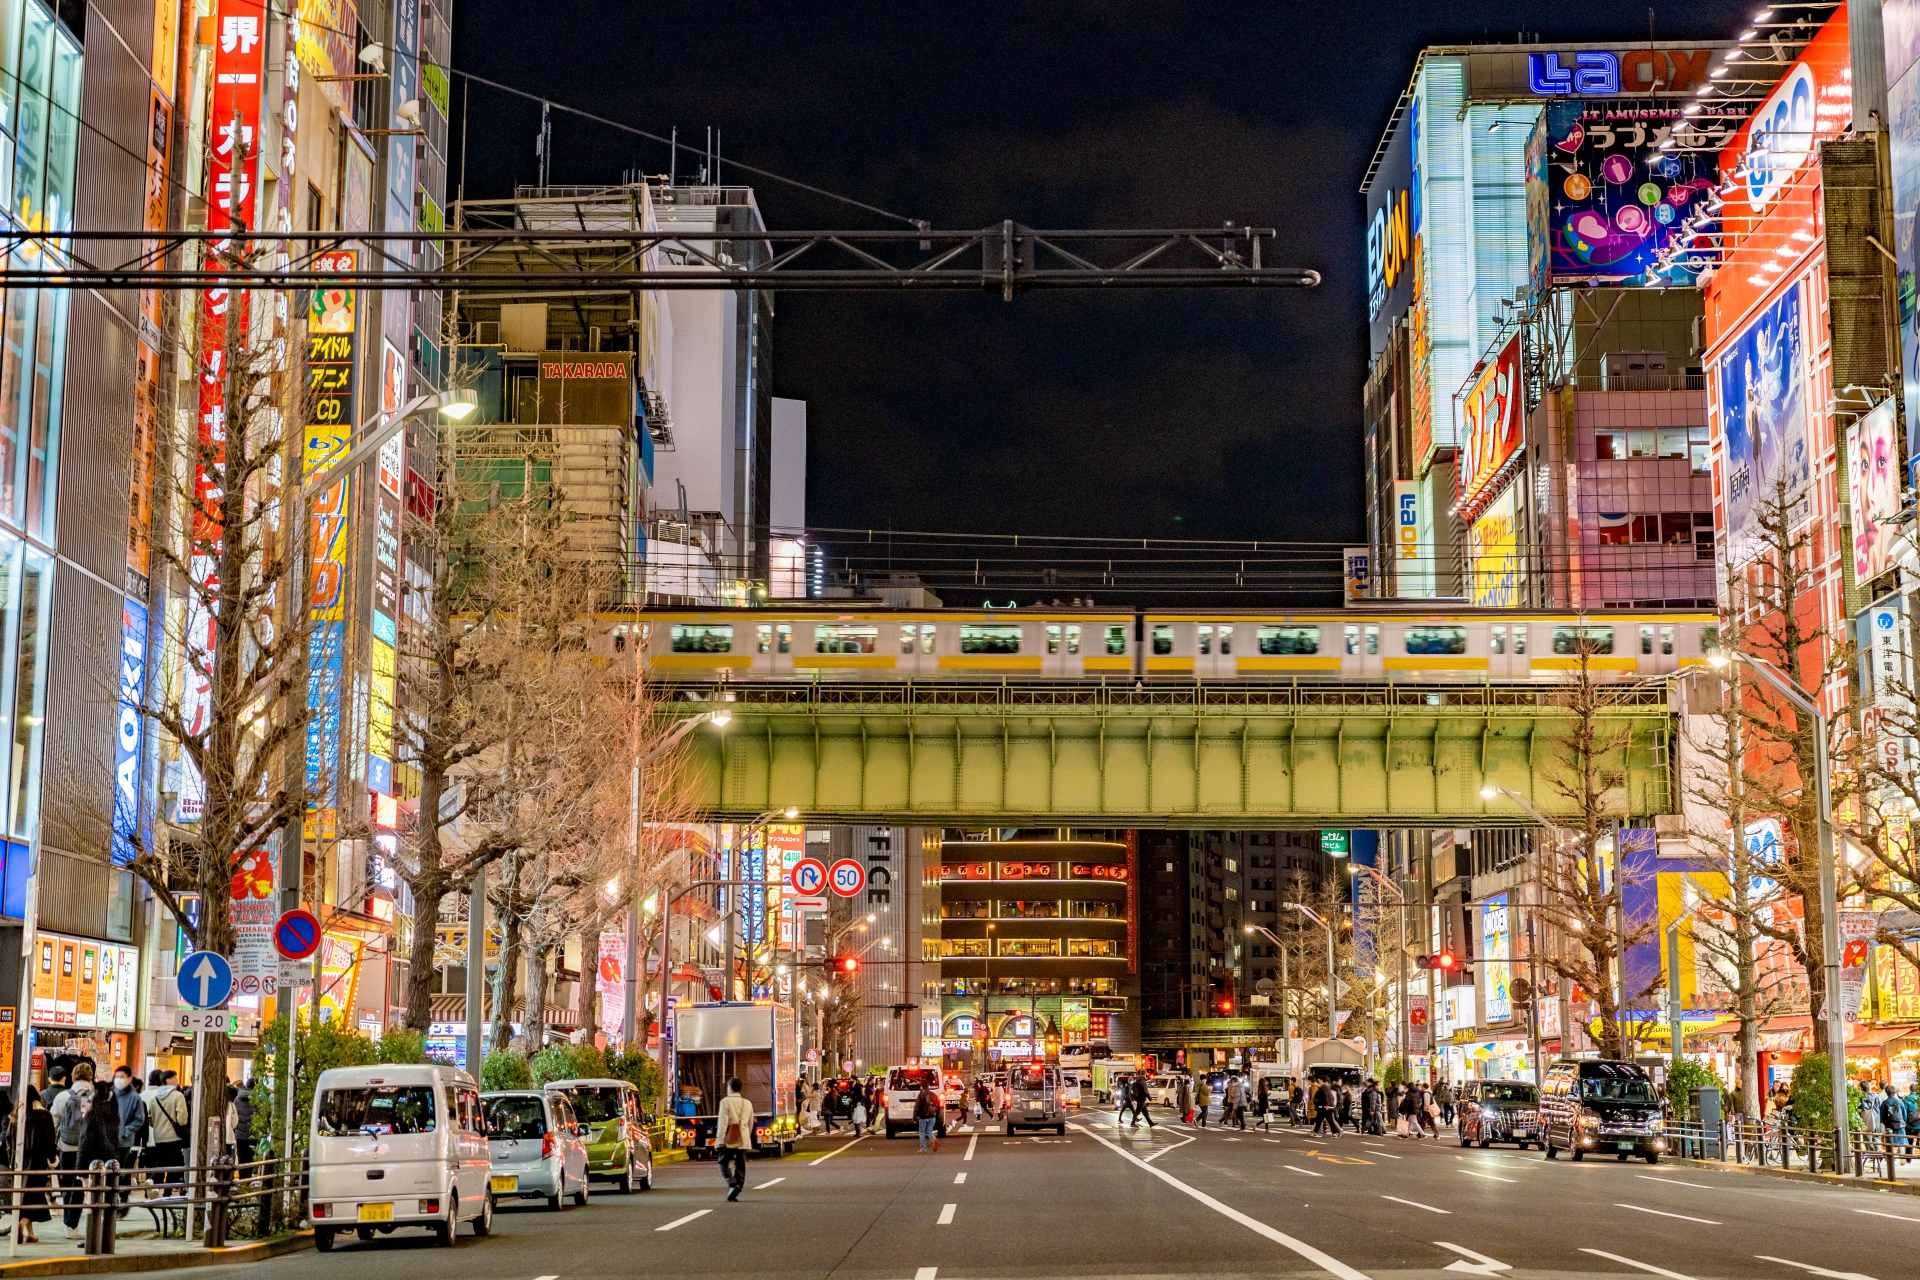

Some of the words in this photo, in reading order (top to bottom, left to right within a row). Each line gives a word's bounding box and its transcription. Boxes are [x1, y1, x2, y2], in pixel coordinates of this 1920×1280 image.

[310, 336, 352, 360] アイドル
[310, 368, 349, 389] アニメ
[543, 362, 627, 379] TAKARADA
[316, 399, 341, 420] CD
[115, 636, 144, 805] AOKI
[837, 869, 857, 886] 50
[1893, 882, 1912, 893] 1F
[1843, 895, 1865, 908] 2F
